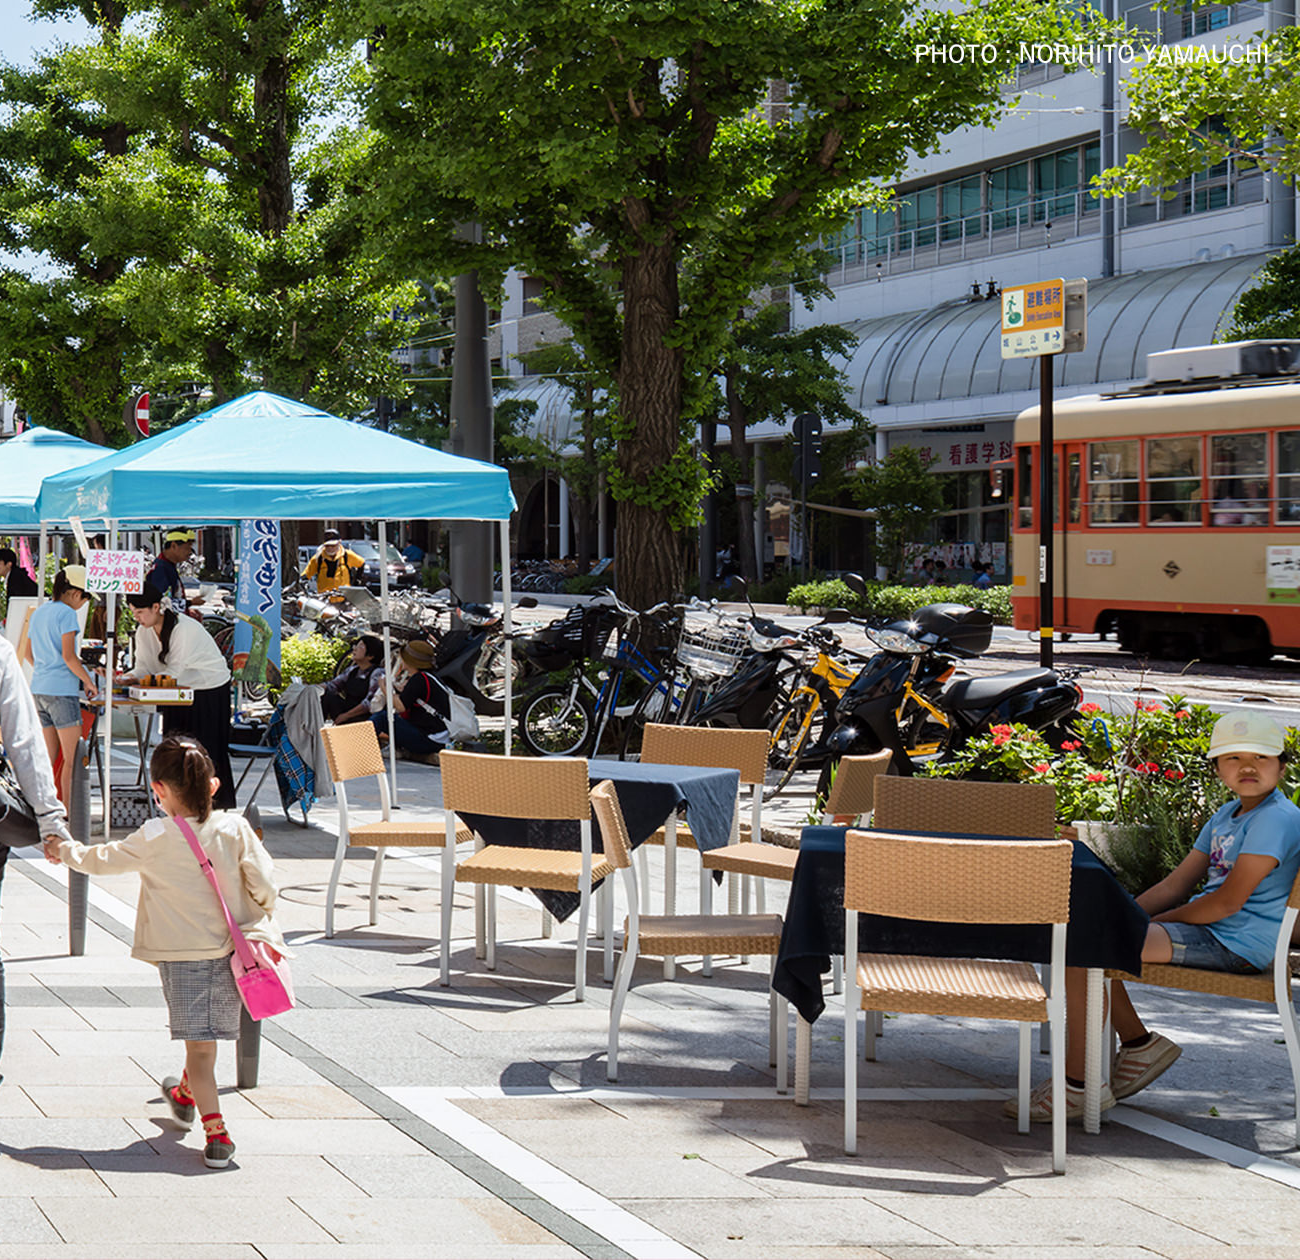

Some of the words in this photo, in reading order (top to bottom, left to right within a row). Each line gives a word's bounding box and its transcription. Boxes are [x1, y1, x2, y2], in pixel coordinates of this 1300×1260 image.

[1027, 287, 1061, 308] 避難場所
[949, 440, 1013, 466] 看護学科
[92, 552, 140, 565] ボードゲーム
[87, 578, 120, 591] ドリンク
[122, 581, 141, 592] 100
